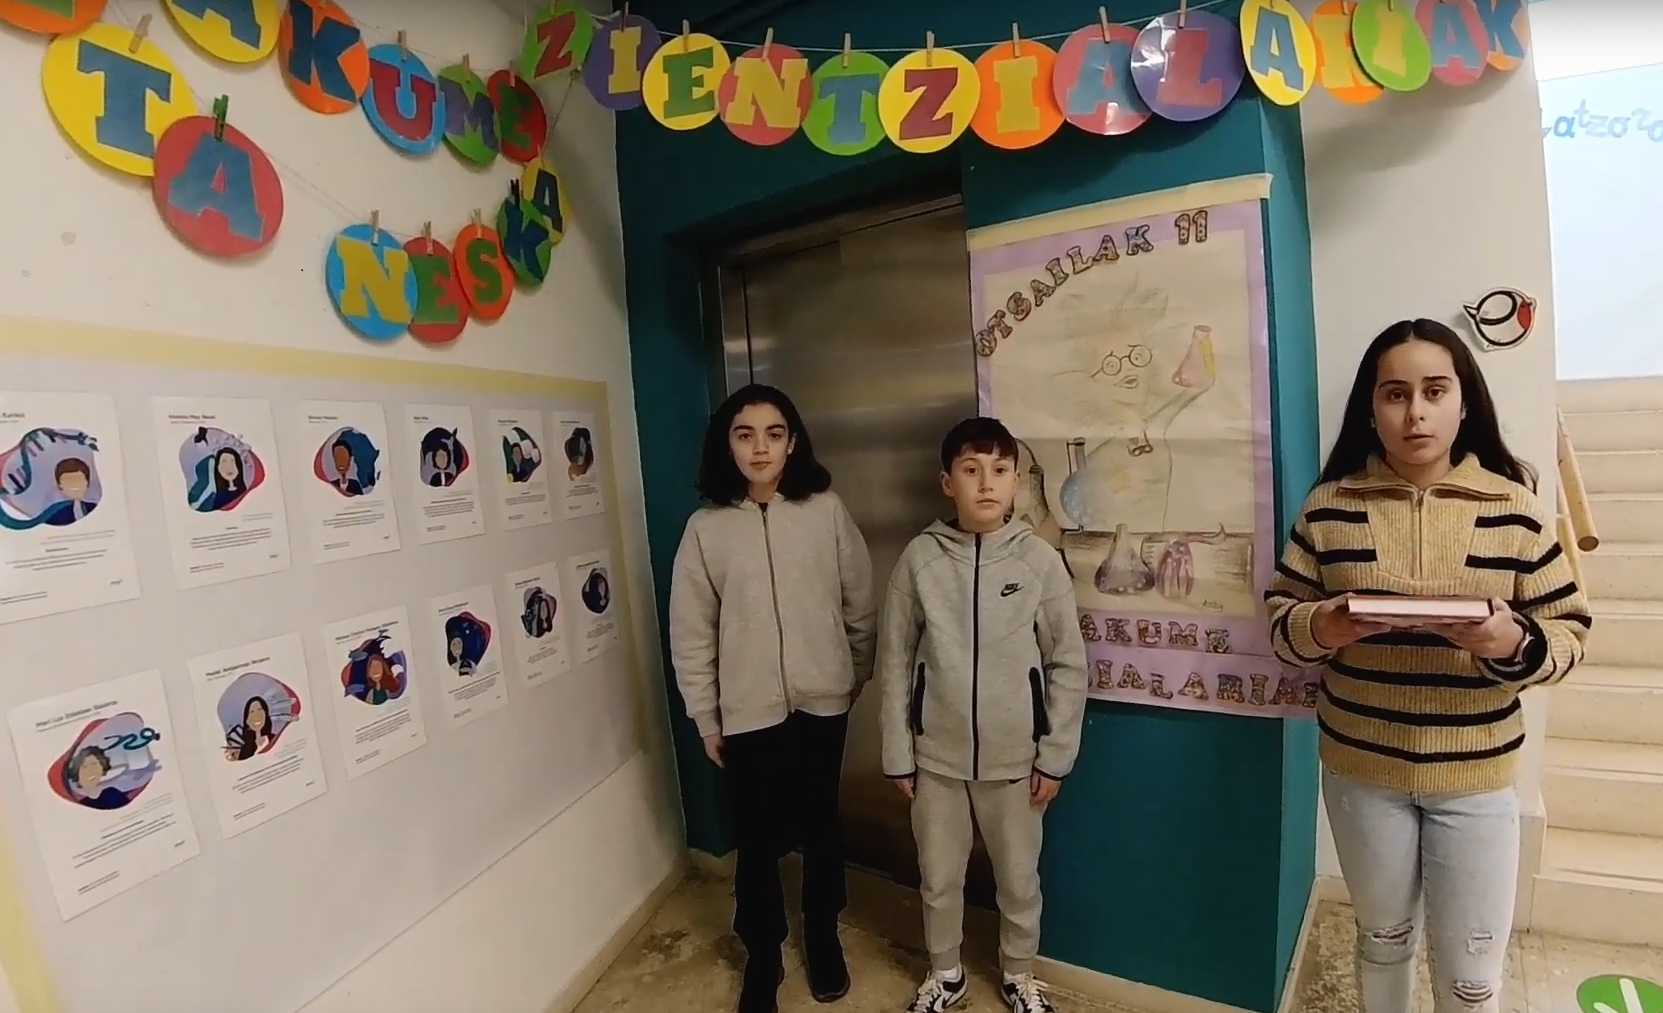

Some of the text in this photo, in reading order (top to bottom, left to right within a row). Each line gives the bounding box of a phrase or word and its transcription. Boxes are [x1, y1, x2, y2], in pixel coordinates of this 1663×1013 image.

[335, 167, 564, 326] NESKA
[975, 210, 1209, 357] OTSAILAK 11
[1084, 658, 1319, 710] IALARIA
